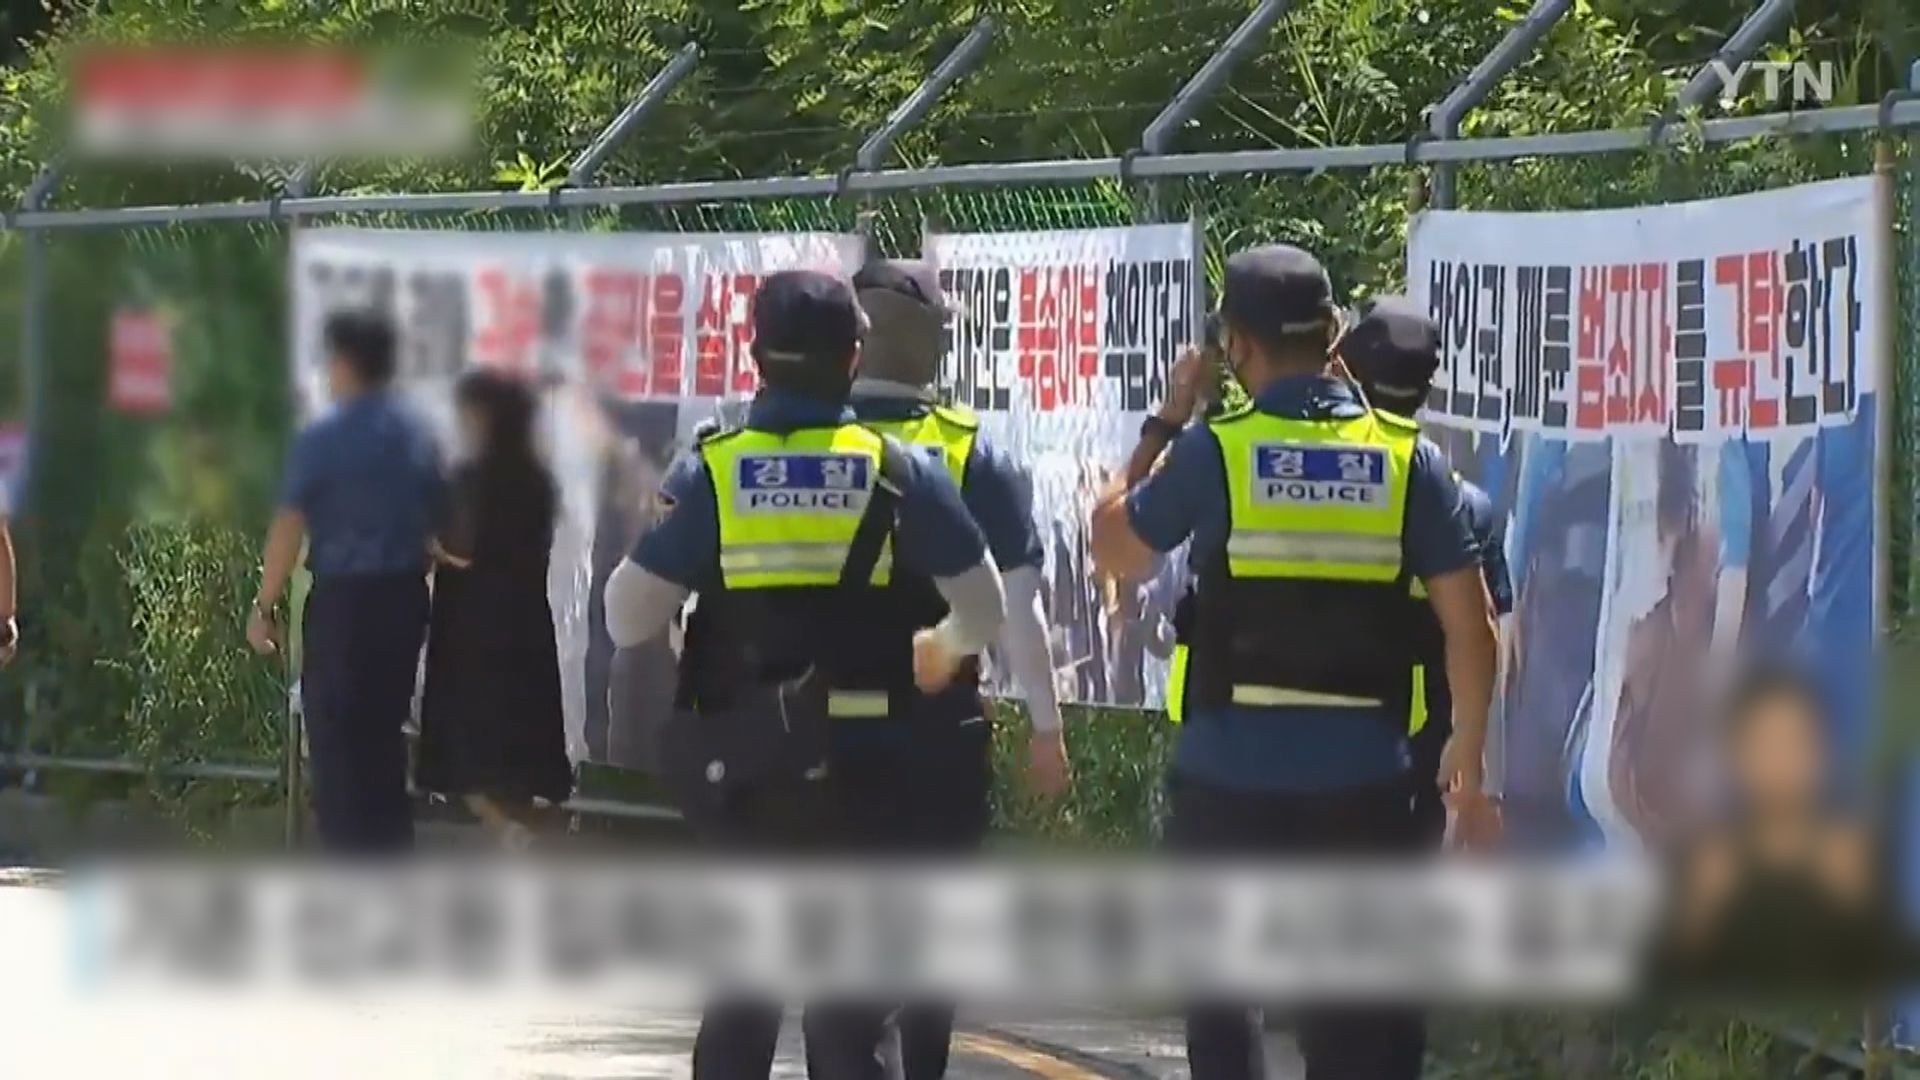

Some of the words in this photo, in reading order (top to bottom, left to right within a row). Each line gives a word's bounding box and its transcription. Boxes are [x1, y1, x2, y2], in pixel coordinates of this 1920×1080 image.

[1018, 263, 1099, 411] 북송어부
[1576, 257, 1706, 432] 범죄자를
[1714, 235, 1861, 429] 규탄한다
[751, 492, 859, 508] POLICE
[1267, 483, 1374, 502] POLICE
